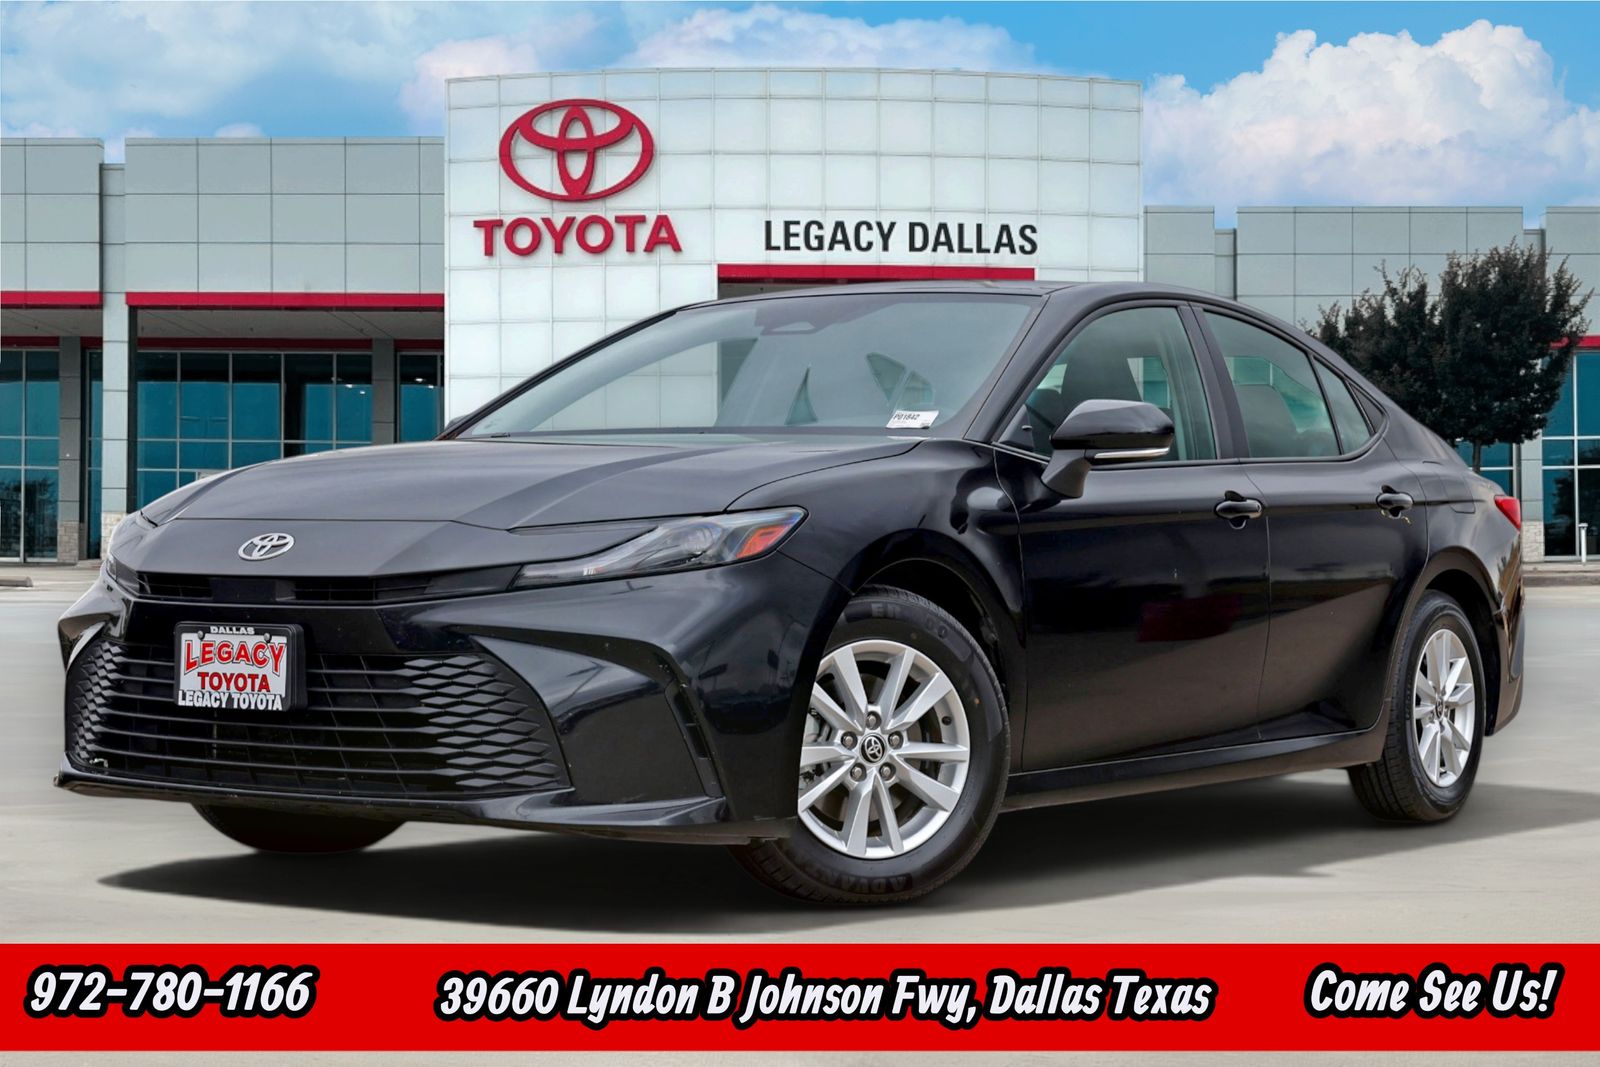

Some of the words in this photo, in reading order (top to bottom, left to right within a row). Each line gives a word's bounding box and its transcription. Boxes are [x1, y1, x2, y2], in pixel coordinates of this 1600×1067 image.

[474, 213, 682, 256] TOYOTA
[764, 220, 898, 252] LEGACY
[908, 221, 1038, 255] DALLAS
[210, 626, 255, 635] DALLAS
[184, 640, 286, 676] LEGACY
[197, 672, 270, 692] TOYOTA
[178, 690, 228, 708] LEGACY
[232, 693, 282, 710] TOYOTA
